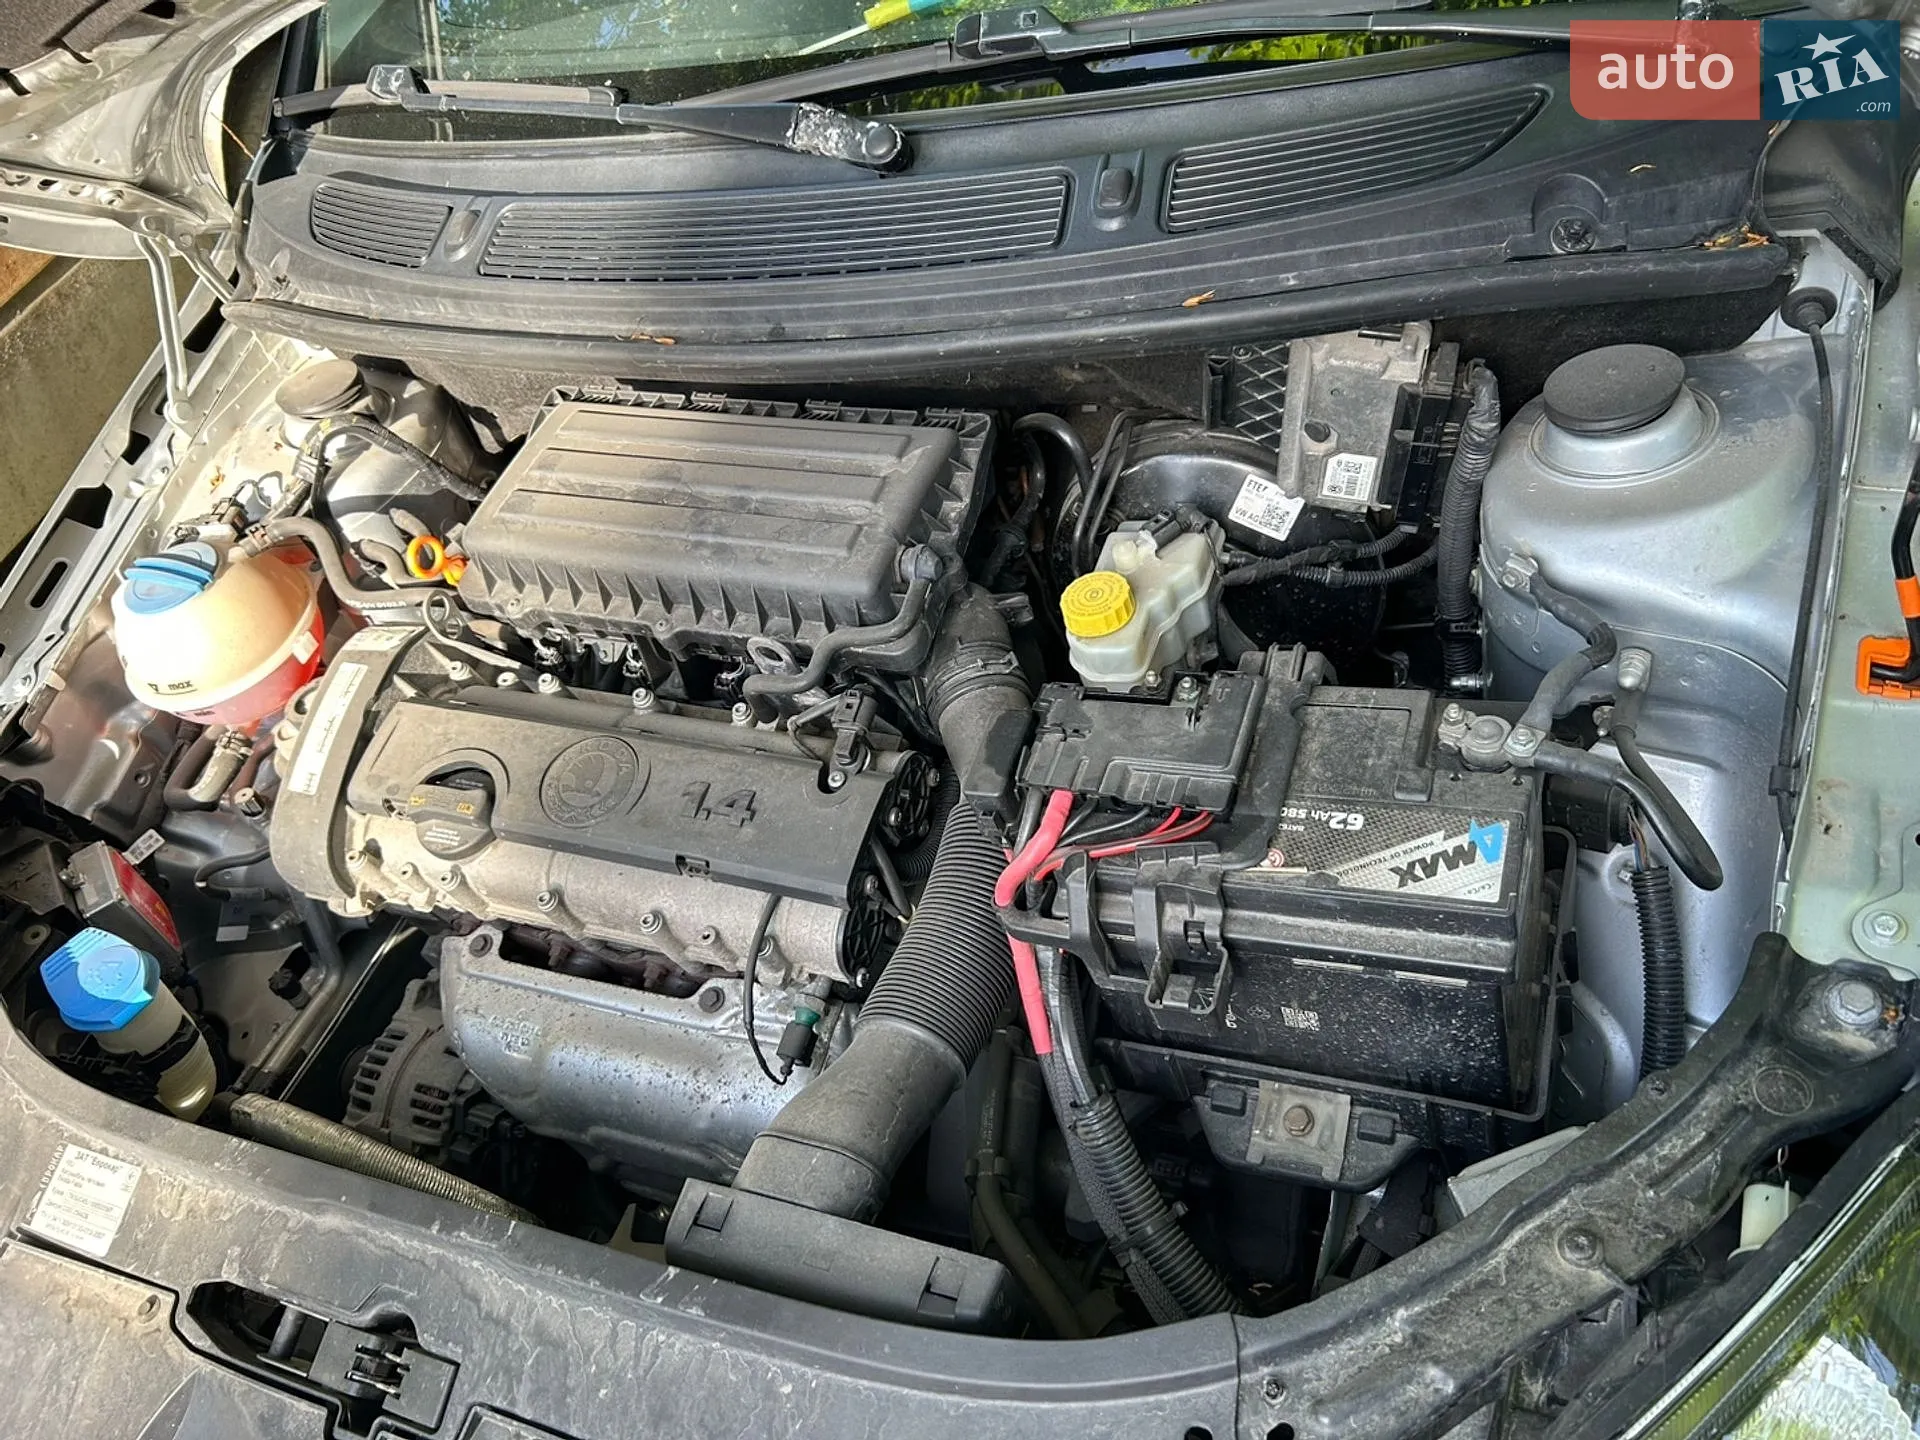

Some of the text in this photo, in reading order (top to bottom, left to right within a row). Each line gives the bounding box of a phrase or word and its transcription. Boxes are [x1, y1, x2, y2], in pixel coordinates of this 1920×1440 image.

[168, 680, 193, 690] max
[1403, 840, 1435, 856] POWER
[1389, 851, 1401, 859] OF
